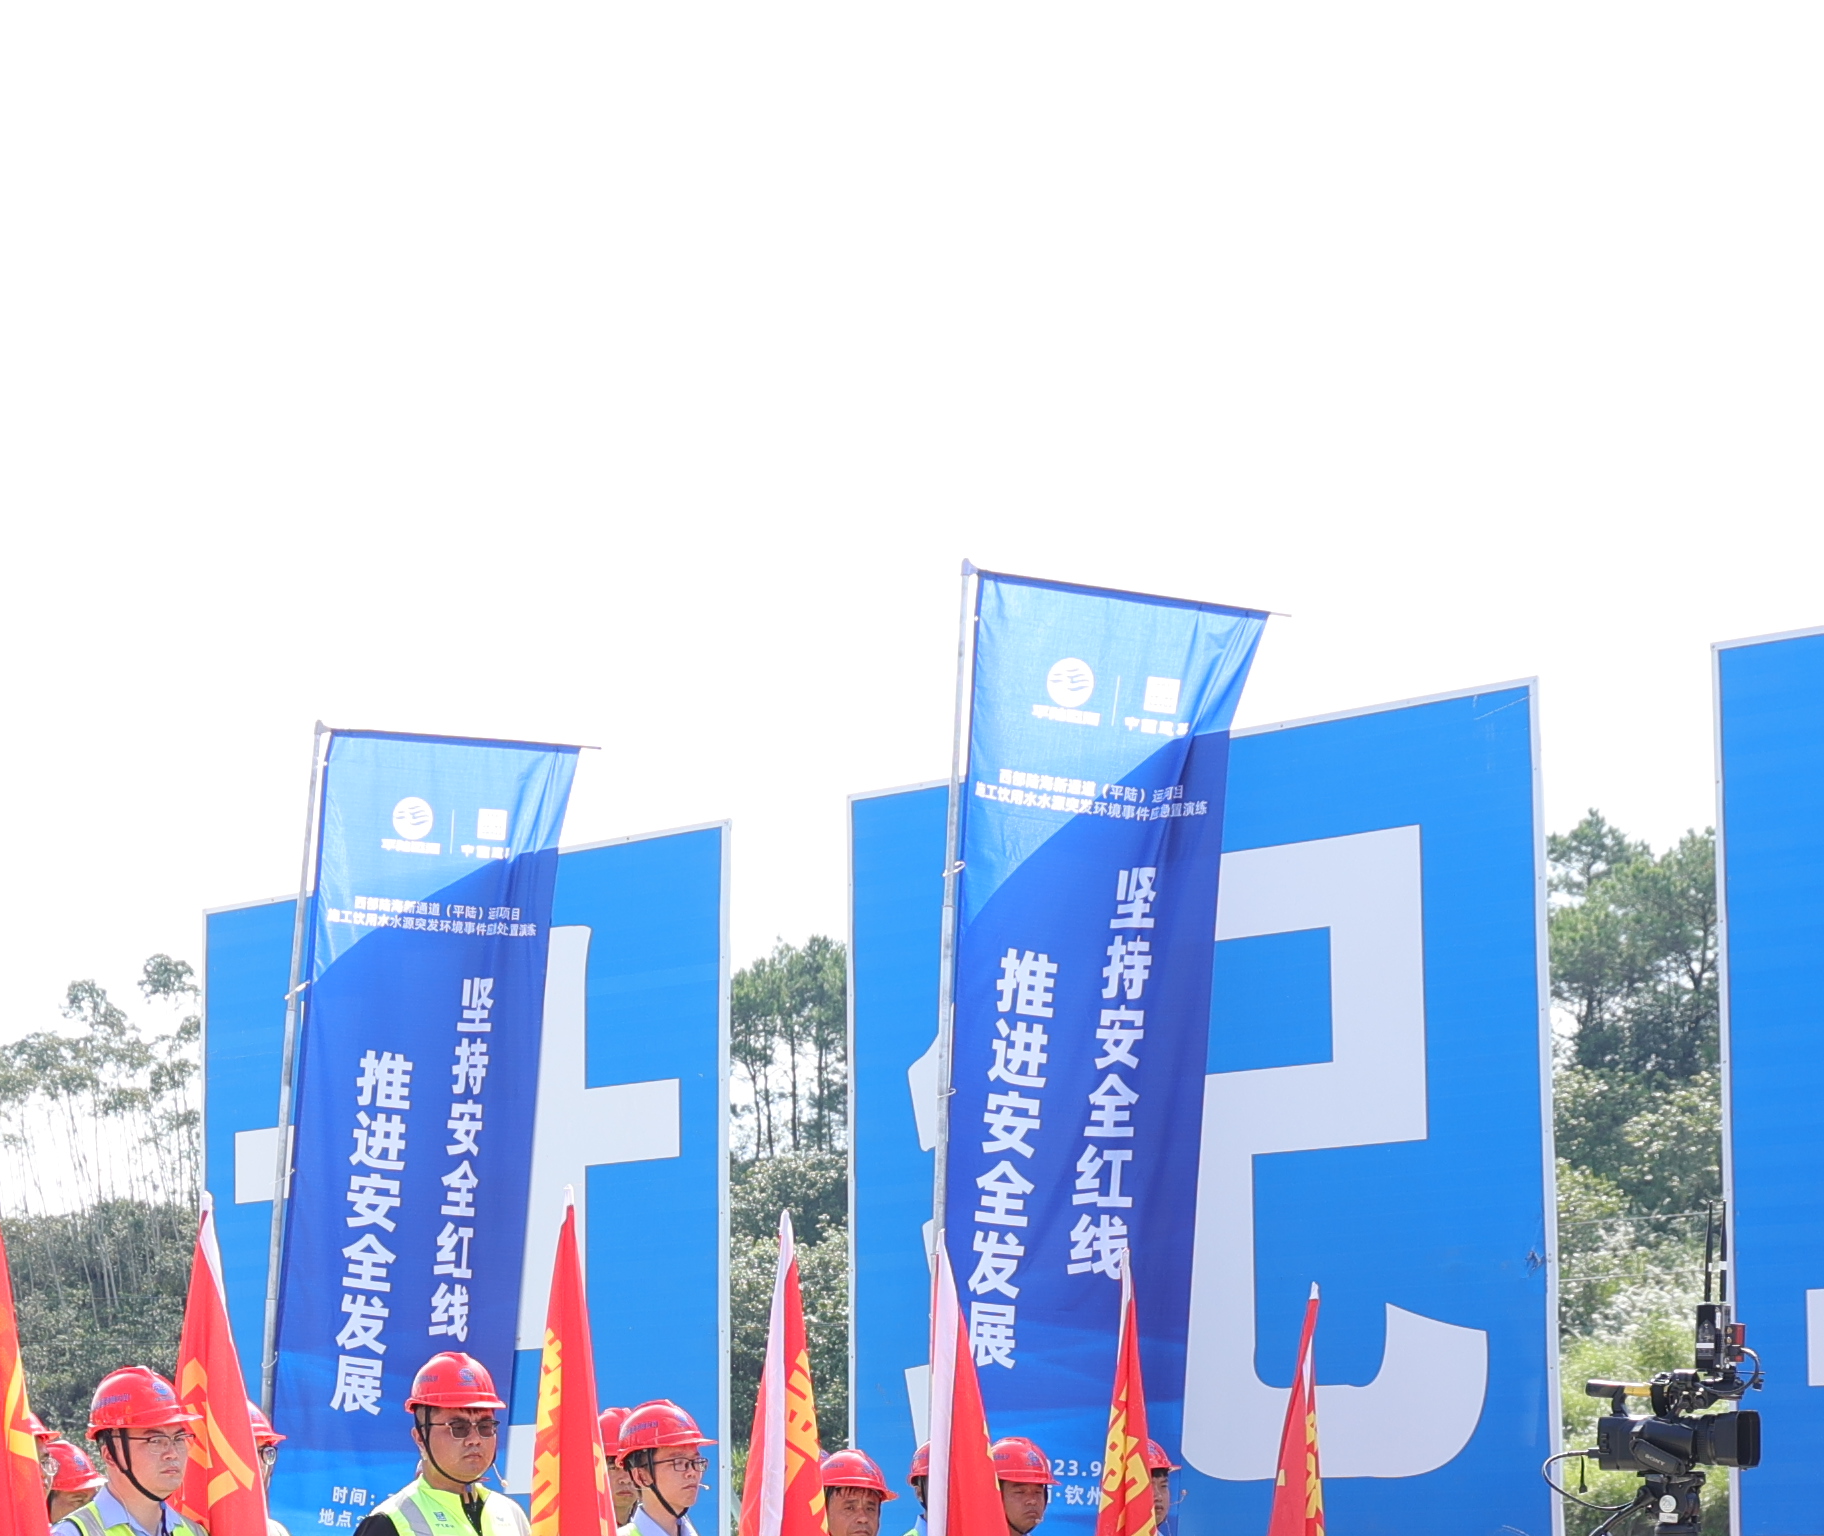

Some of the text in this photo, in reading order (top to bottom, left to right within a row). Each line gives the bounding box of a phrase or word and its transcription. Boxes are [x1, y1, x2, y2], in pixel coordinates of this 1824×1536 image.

[330, 1050, 413, 1416] 推进安全发展
[428, 977, 494, 1343] 坚持安全红线
[968, 947, 1059, 1370] 推进安全发展
[1067, 867, 1156, 1281] 坚持安全红线
[1047, 1459, 1102, 1477] 23.9
